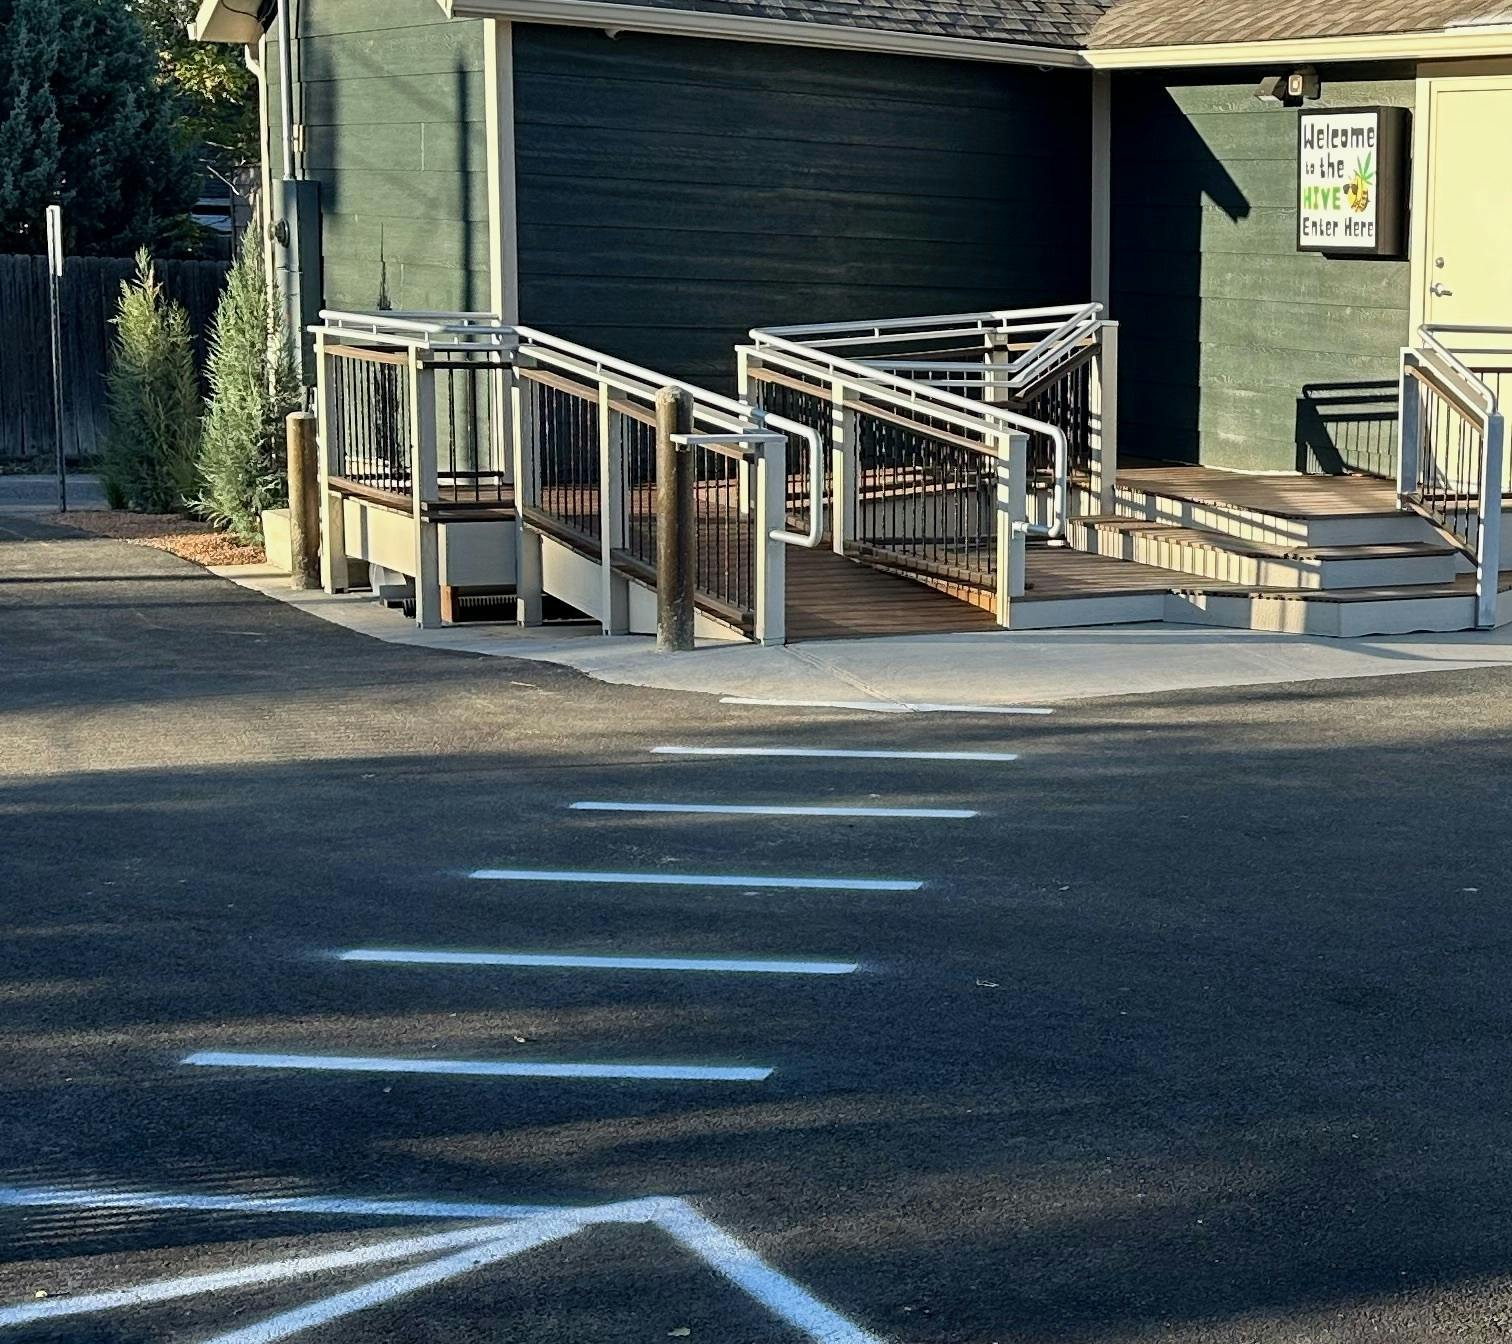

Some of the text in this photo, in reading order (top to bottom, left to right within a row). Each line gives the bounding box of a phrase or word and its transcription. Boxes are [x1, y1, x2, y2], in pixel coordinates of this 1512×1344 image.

[1303, 123, 1375, 149] Welcome
[1305, 152, 1344, 178] to the
[1303, 186, 1341, 210] HIVE
[1302, 216, 1374, 237] Enter Here
